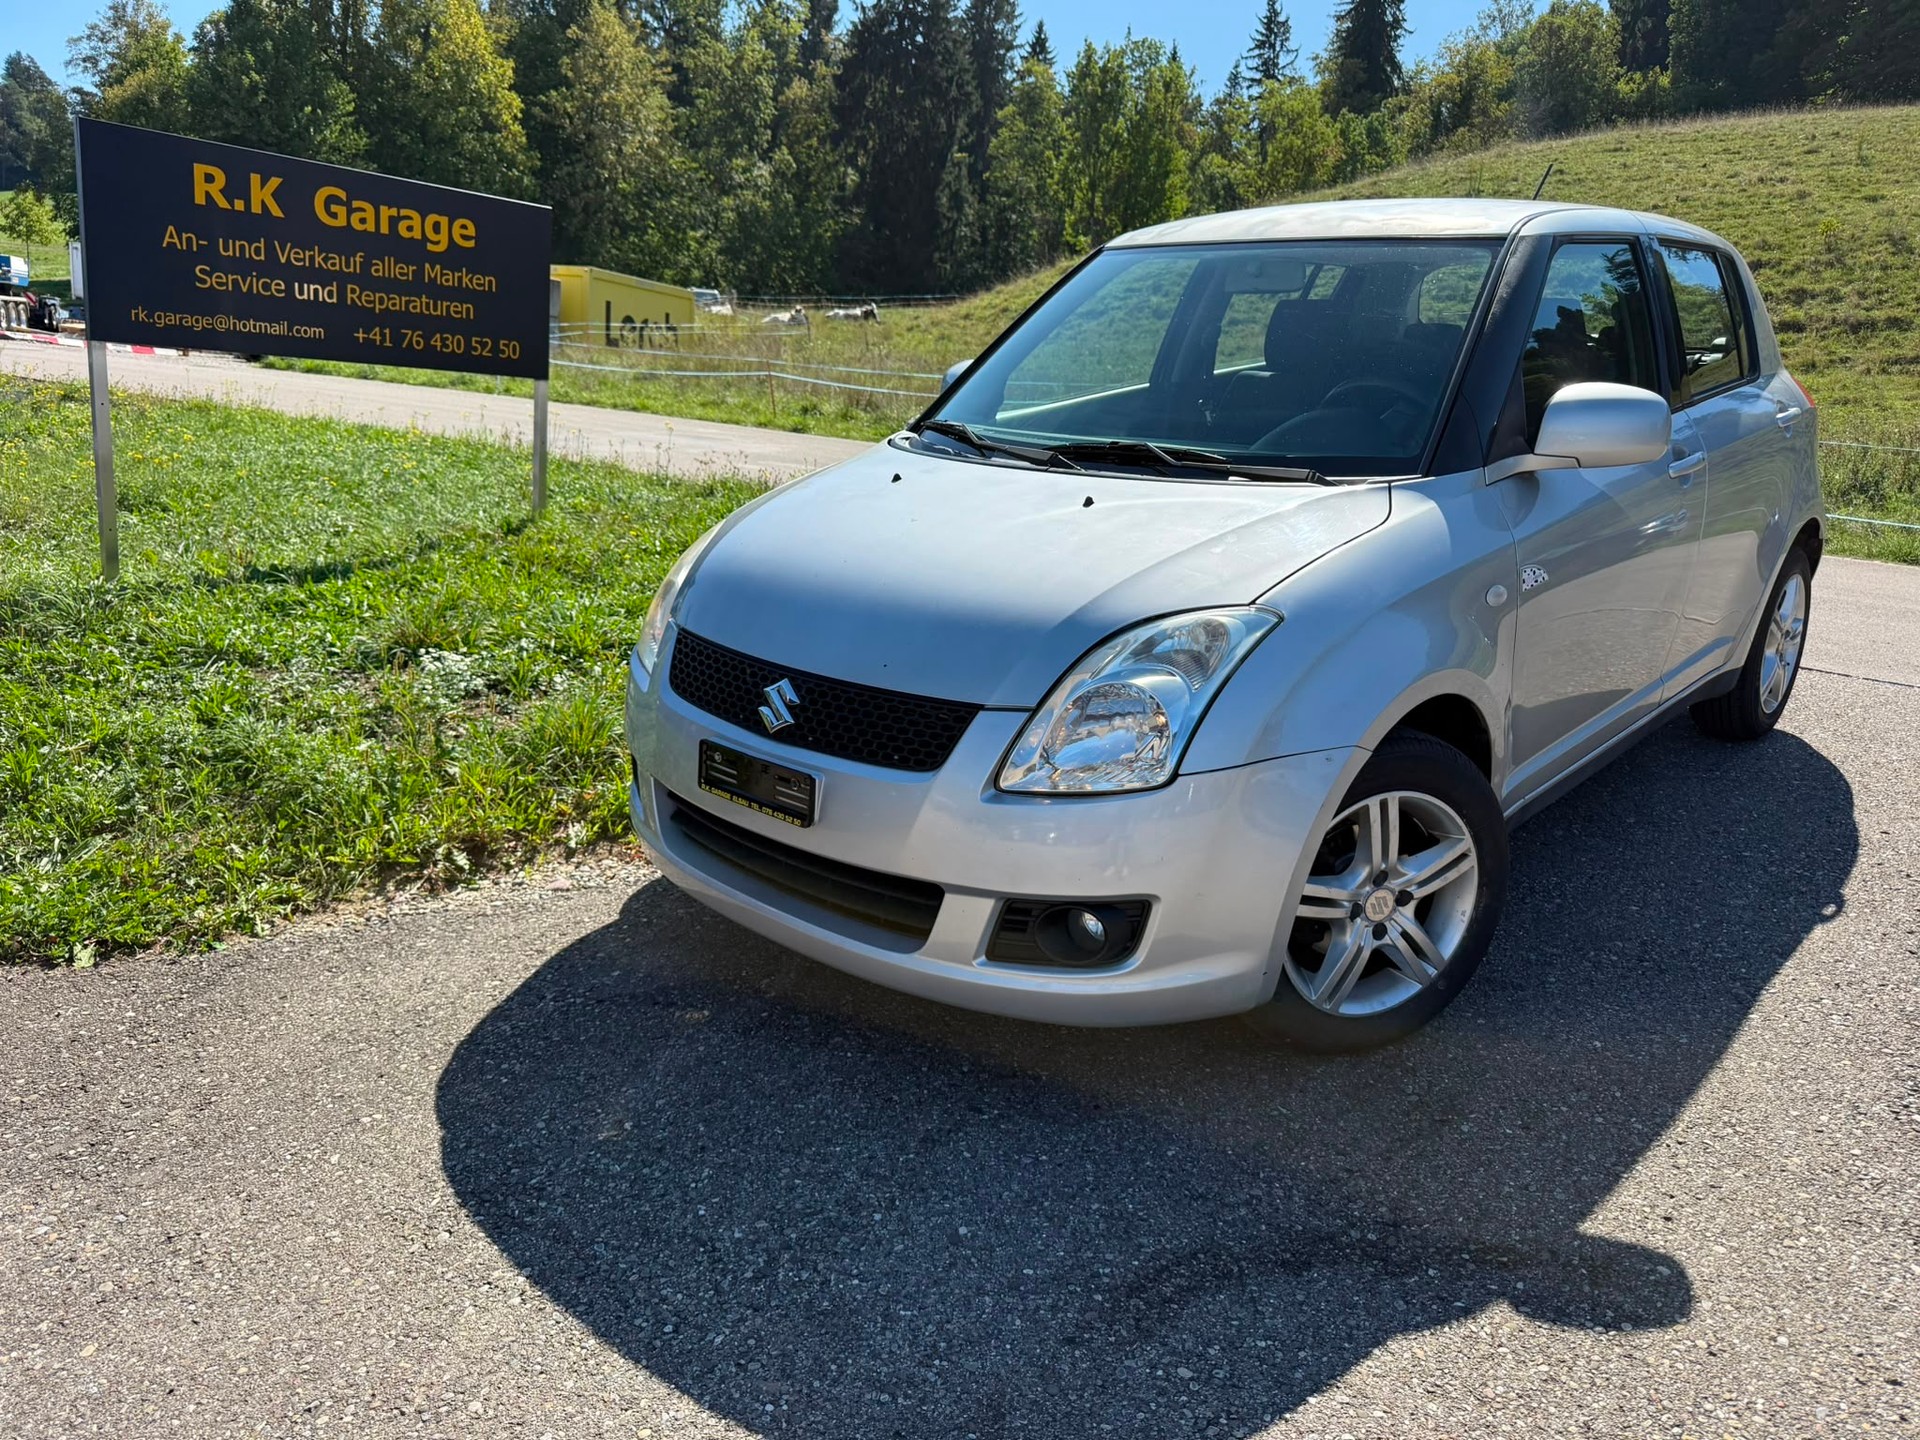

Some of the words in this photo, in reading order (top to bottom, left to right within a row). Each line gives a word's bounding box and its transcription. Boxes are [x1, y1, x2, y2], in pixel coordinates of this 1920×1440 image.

[193, 163, 285, 217] R.K
[314, 185, 477, 253] Garage
[162, 225, 209, 252] An-
[218, 237, 266, 261] und
[274, 240, 364, 274] Verkauf
[370, 256, 417, 282] aller
[424, 263, 496, 293] Marken
[195, 265, 286, 298] Service
[294, 281, 338, 304] und
[346, 284, 474, 320] Reparaturen
[130, 306, 325, 340] rk.garage@hotmail.com
[353, 327, 392, 347] +41
[402, 330, 424, 350] 76
[430, 333, 465, 354] 430
[471, 337, 492, 357] 52
[499, 340, 520, 360] 50
